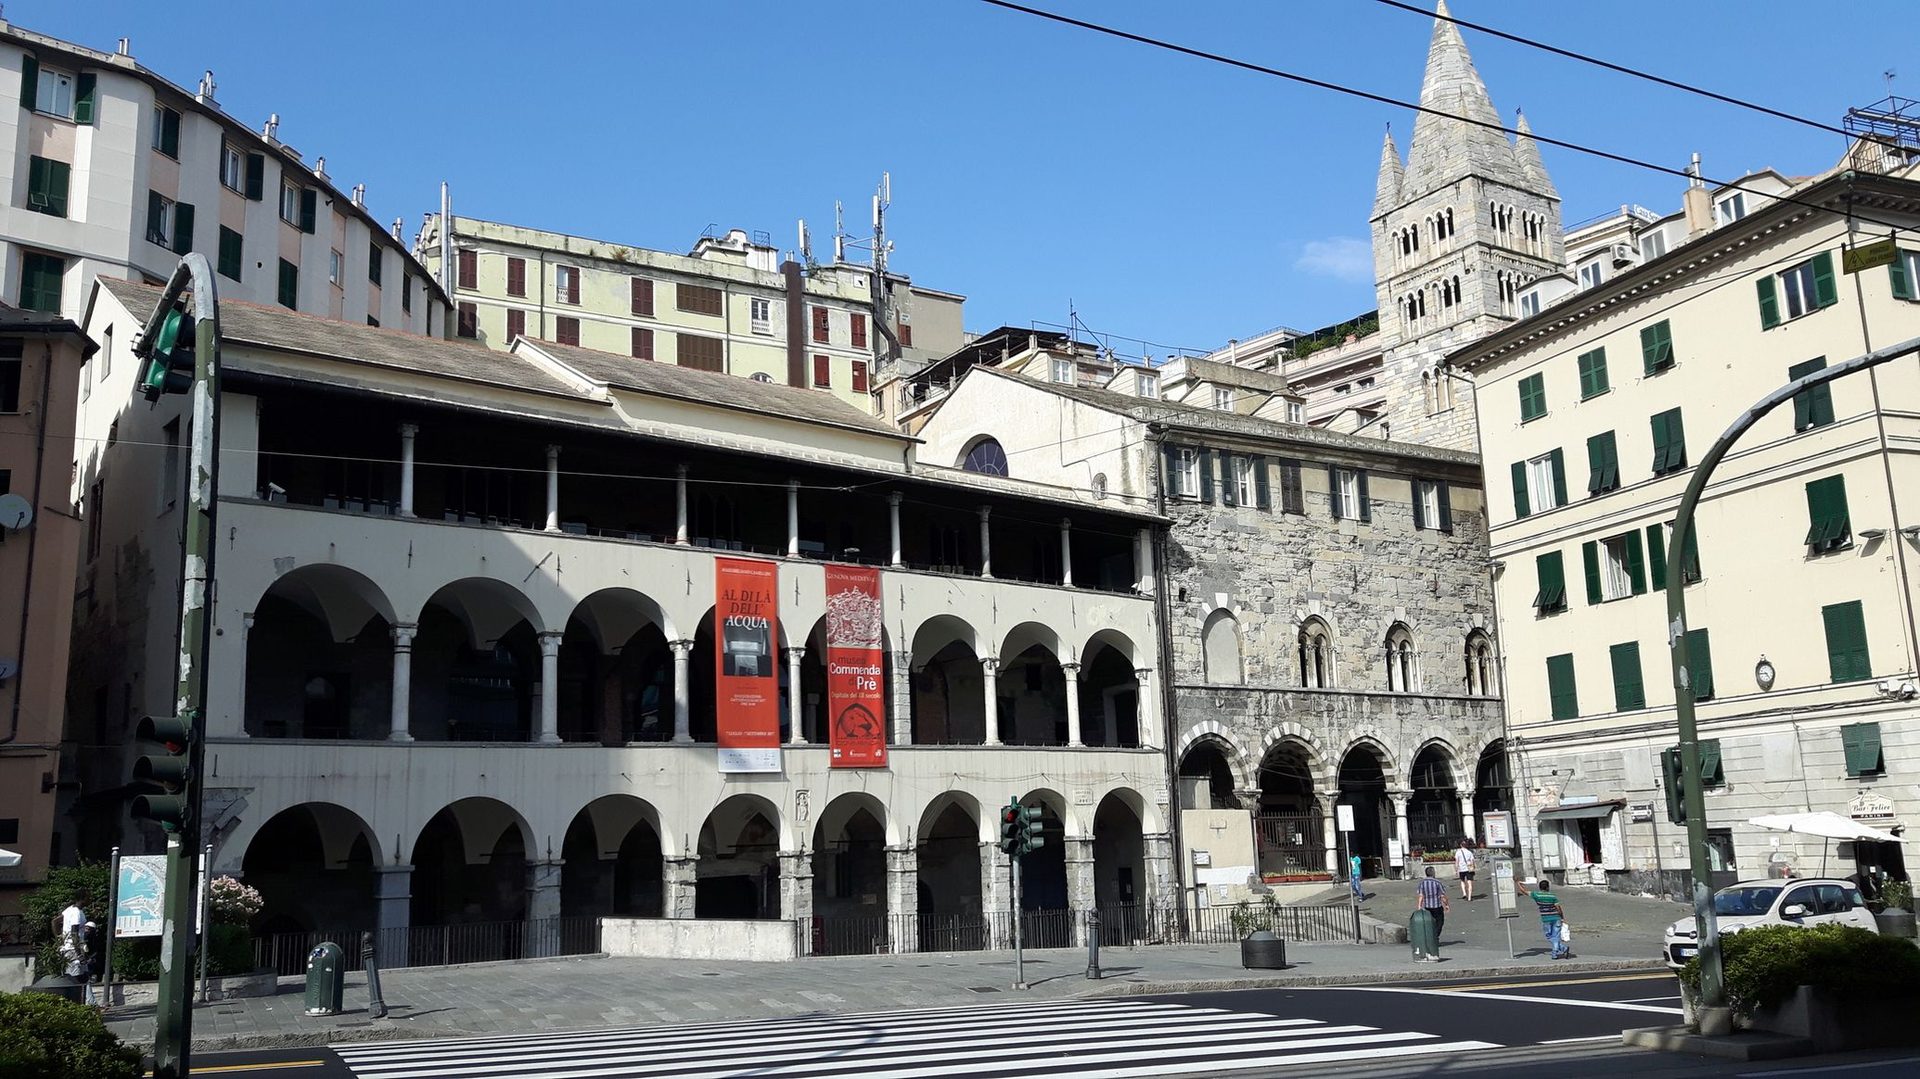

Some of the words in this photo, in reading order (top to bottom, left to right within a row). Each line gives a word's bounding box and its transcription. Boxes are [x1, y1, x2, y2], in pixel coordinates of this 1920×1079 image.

[722, 589, 737, 601] AL
[741, 590, 753, 602] DI
[730, 602, 764, 615] DELL'
[726, 615, 768, 630] ACQUA
[830, 662, 881, 675] Commenda
[856, 676, 877, 691] Prè
